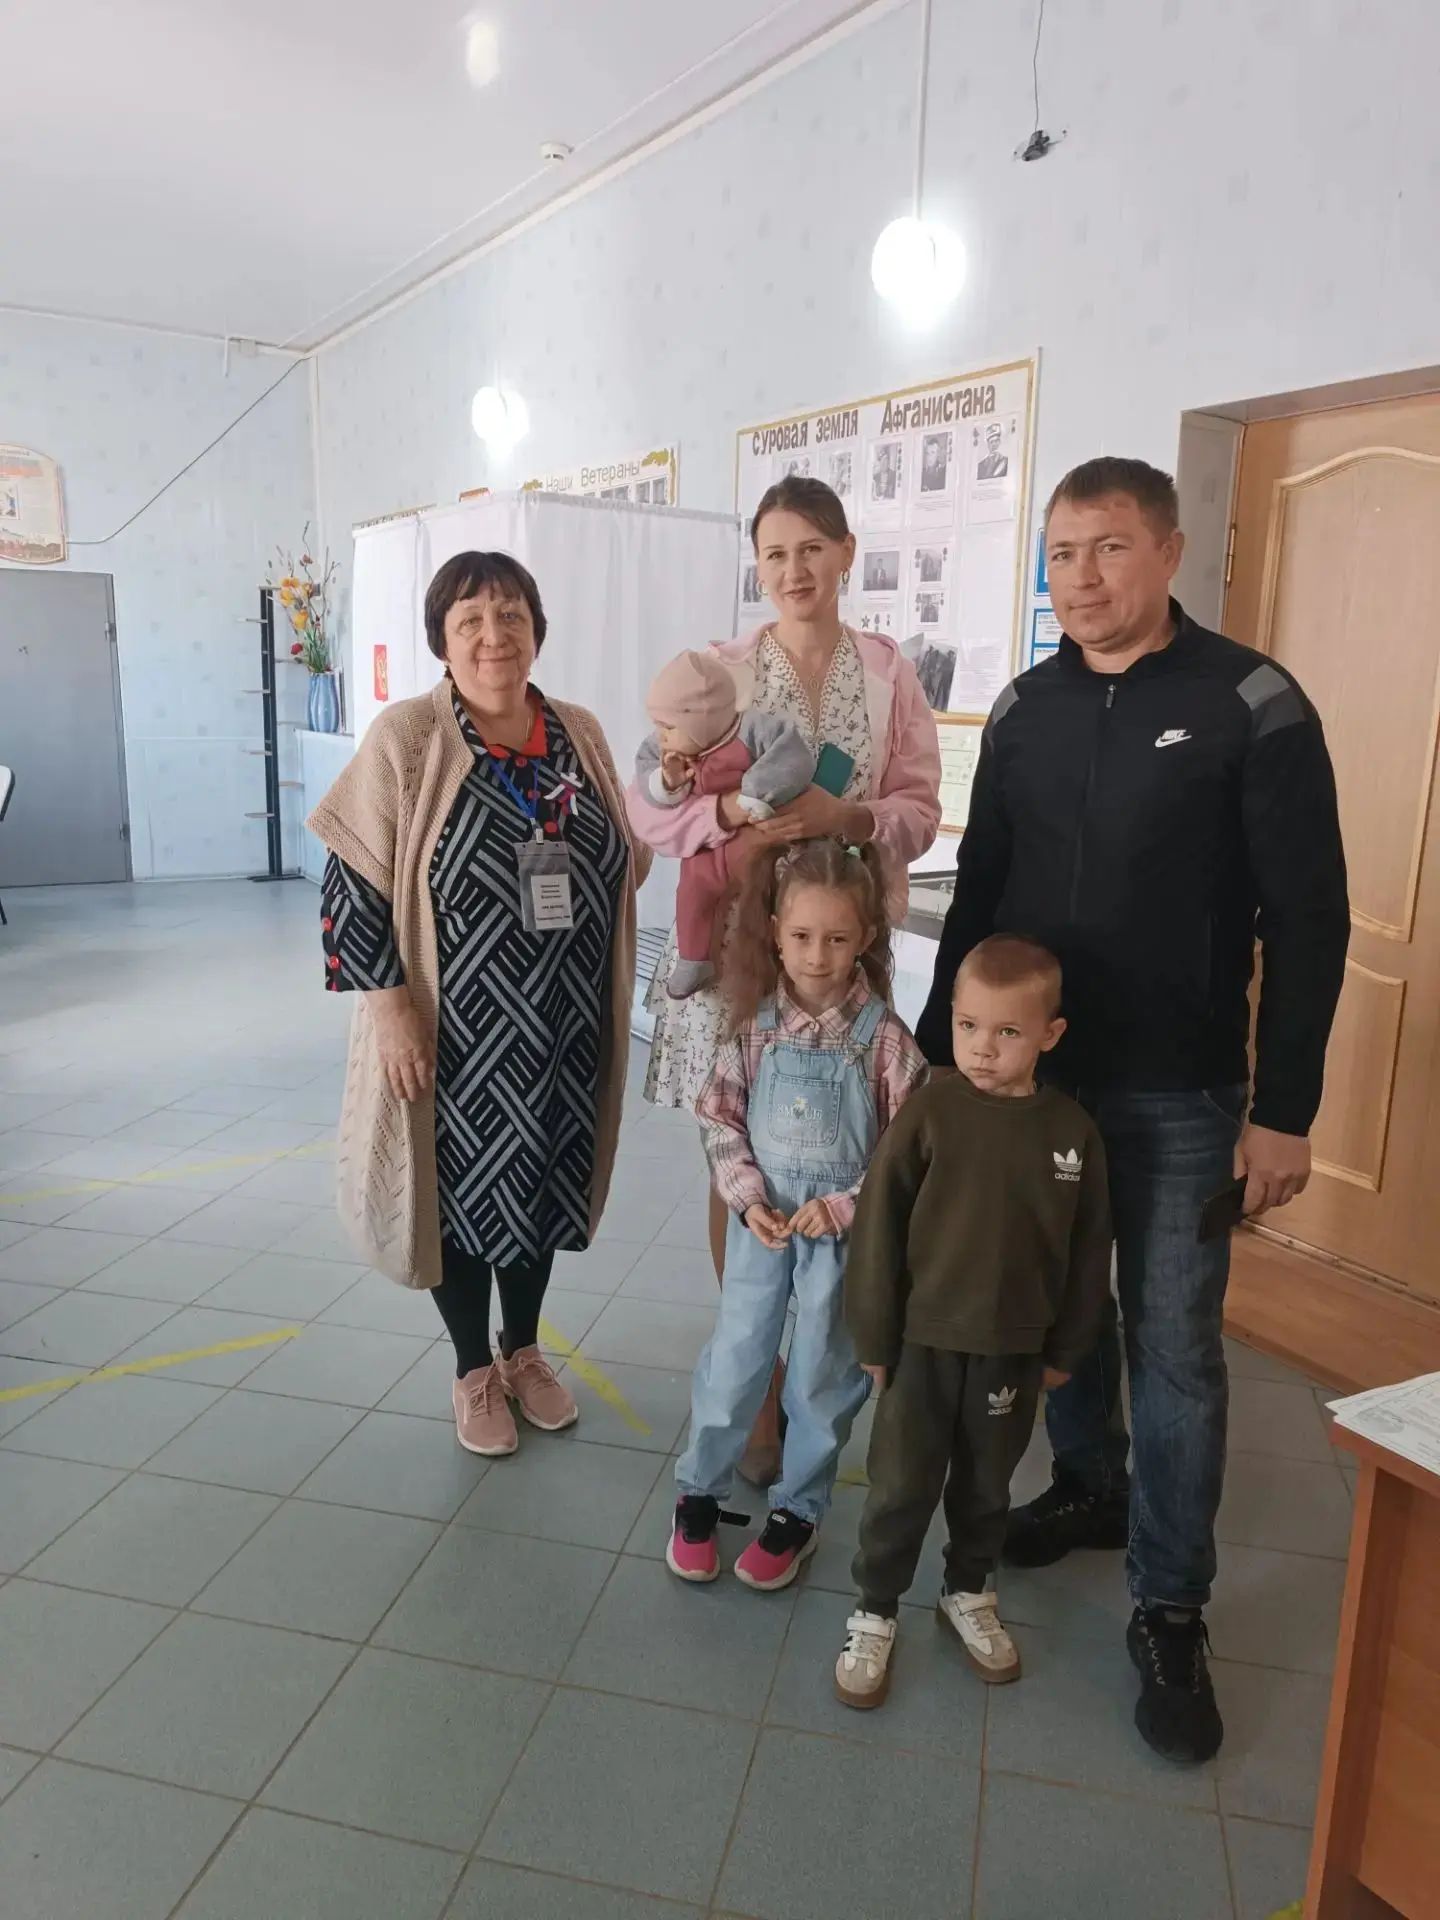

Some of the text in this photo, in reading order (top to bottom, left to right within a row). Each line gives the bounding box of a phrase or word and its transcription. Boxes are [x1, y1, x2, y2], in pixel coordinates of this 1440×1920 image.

[816, 409, 858, 443] земля
[880, 384, 996, 435] Афганистана
[546, 460, 641, 492] Наши Ветераны
